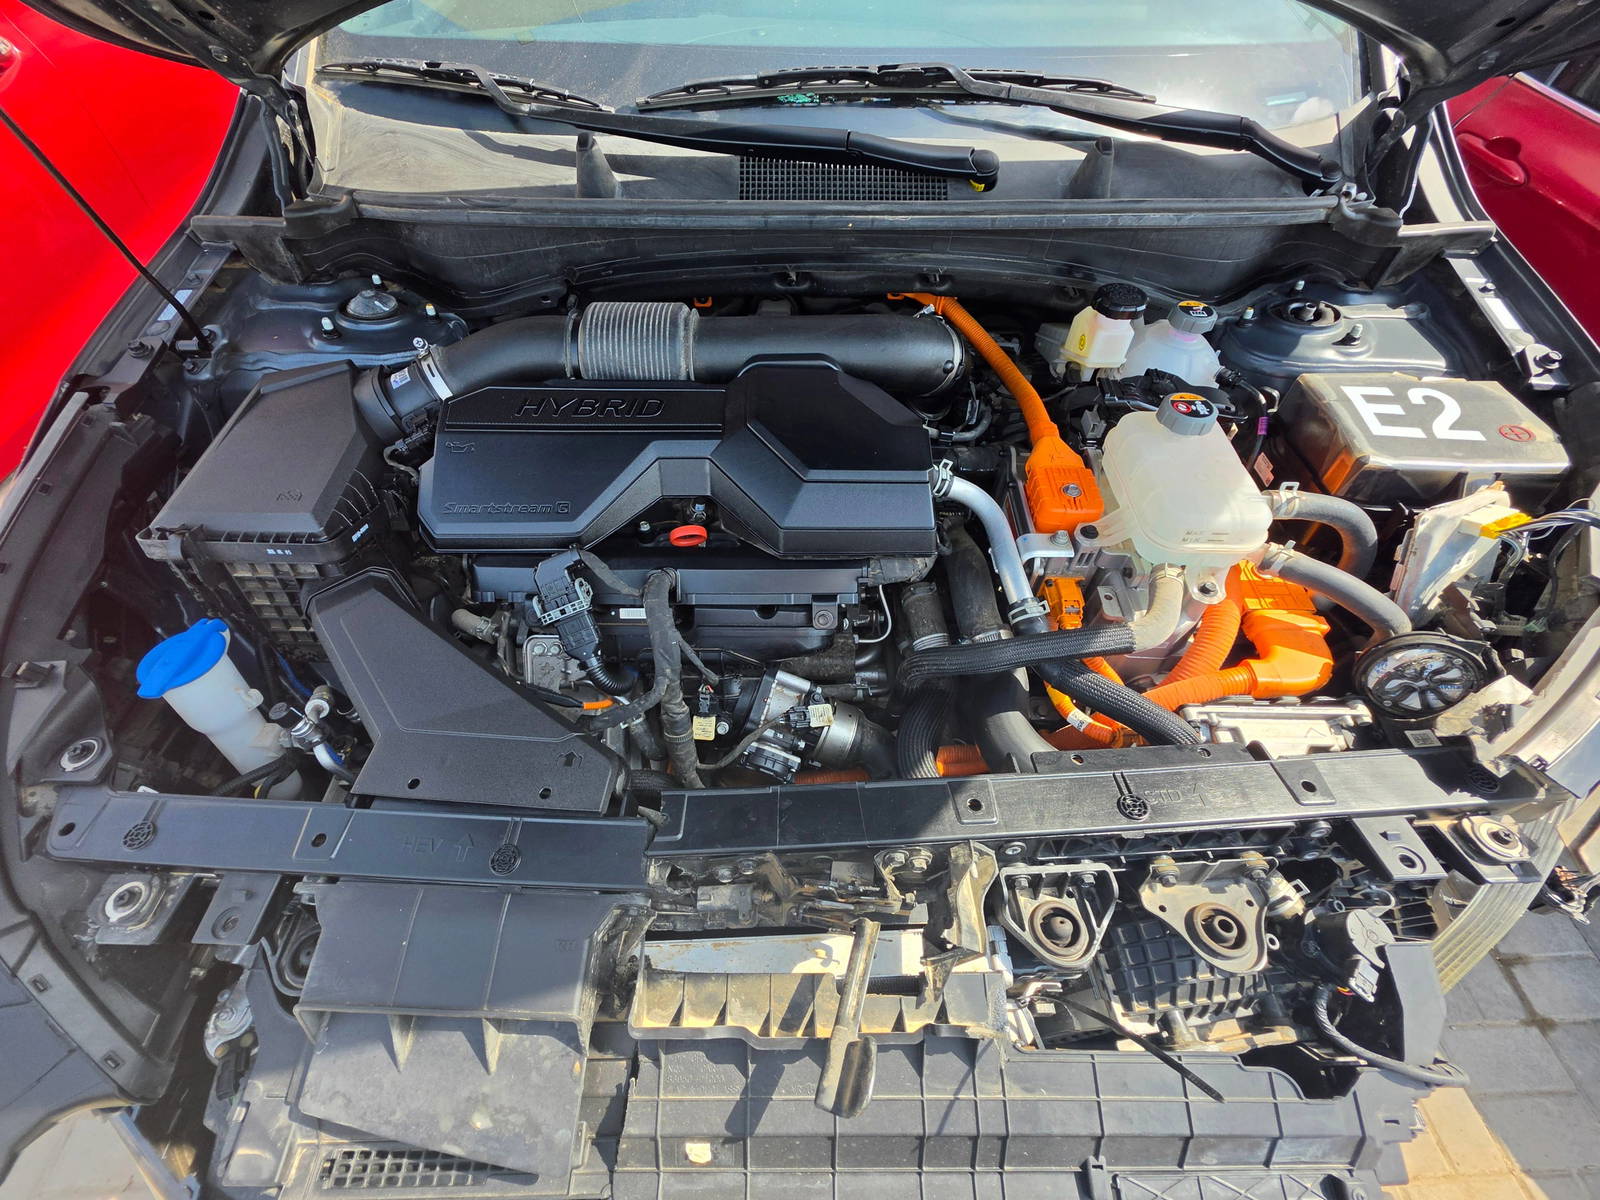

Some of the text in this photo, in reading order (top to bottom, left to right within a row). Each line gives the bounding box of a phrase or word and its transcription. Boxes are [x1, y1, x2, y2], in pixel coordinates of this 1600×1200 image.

[514, 397, 665, 418] HYBRID
[1340, 385, 1487, 441] E2
[442, 500, 571, 514] Smartstream G
[1144, 788, 1183, 804] STD
[403, 836, 444, 854] HEV
